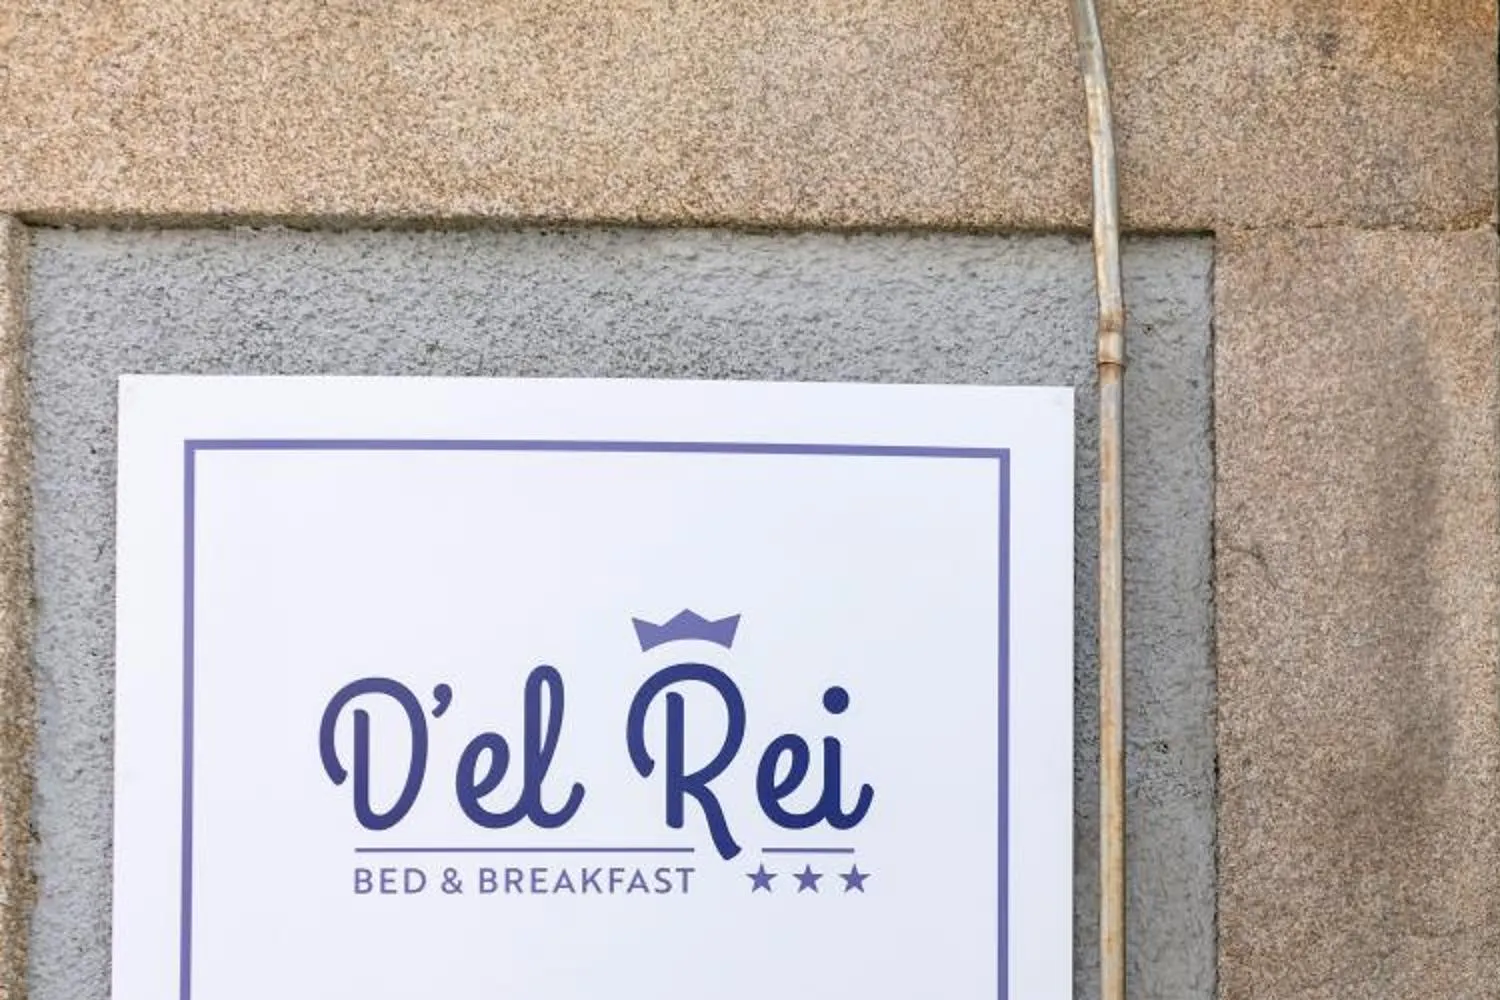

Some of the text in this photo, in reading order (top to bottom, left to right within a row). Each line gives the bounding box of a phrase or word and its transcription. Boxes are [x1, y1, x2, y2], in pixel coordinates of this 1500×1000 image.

[319, 663, 874, 860] D'el Rei
[355, 868, 695, 894] BED & BREAKFAST
